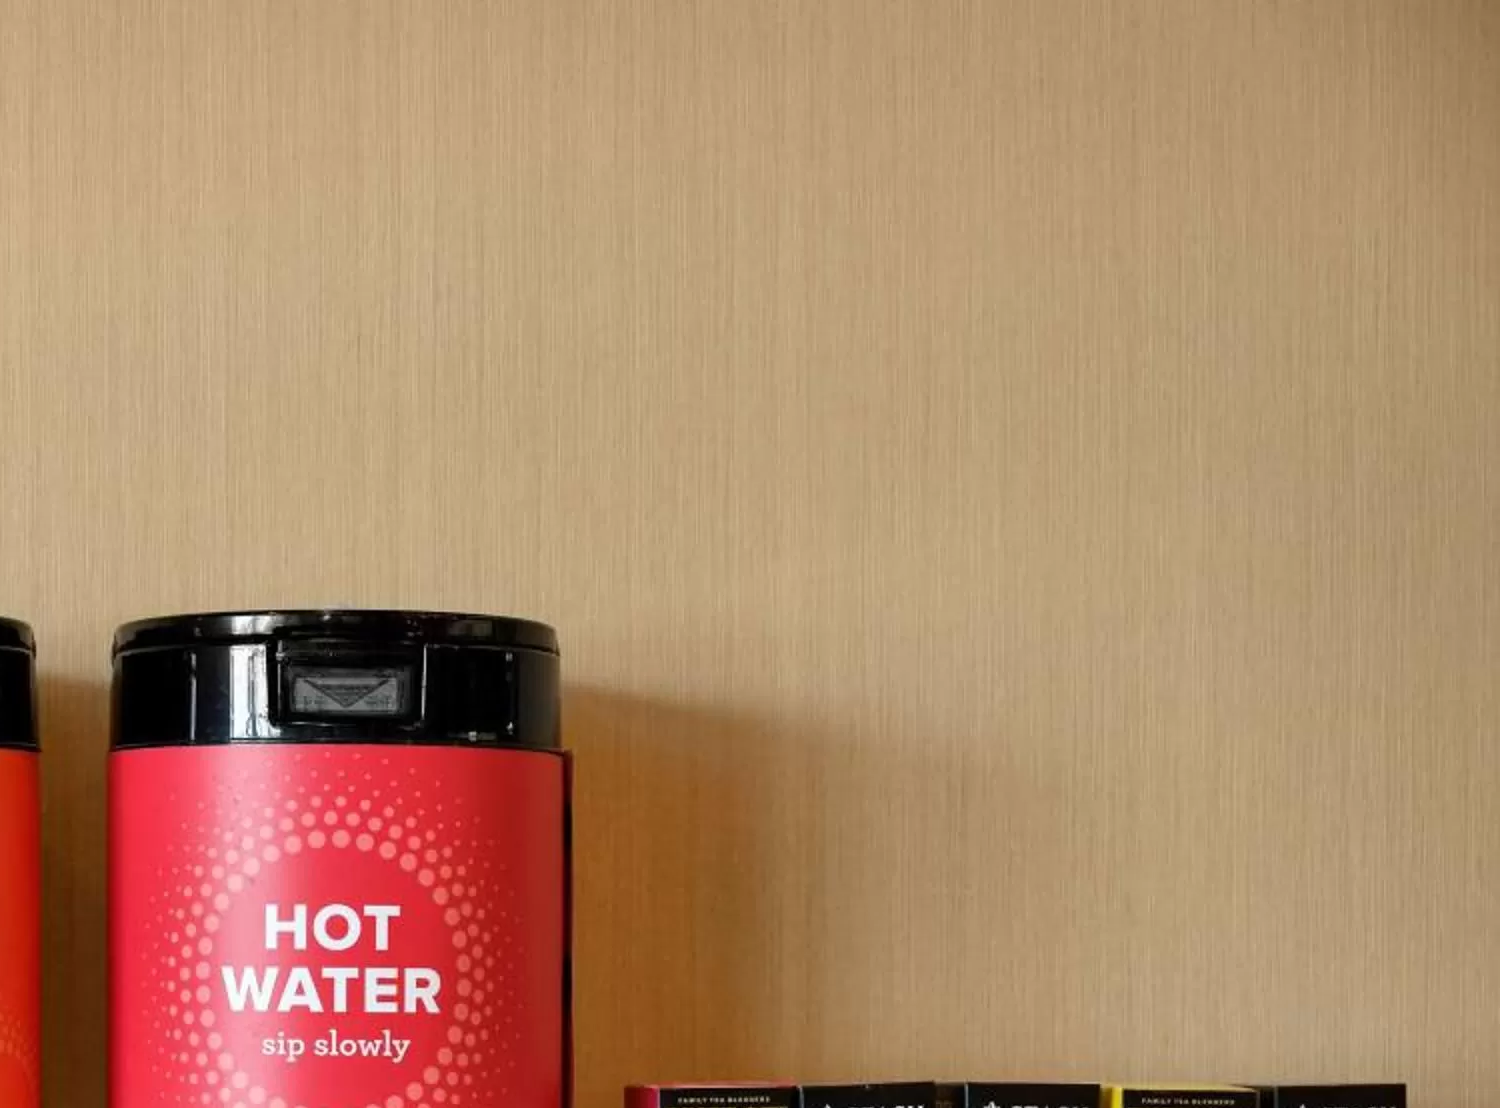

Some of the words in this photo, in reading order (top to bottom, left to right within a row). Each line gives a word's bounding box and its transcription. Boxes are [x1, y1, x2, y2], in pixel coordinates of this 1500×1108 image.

[264, 904, 400, 951] HOT
[221, 966, 442, 1014] WATER
[261, 1030, 305, 1063] sip
[314, 1028, 411, 1063] slowly
